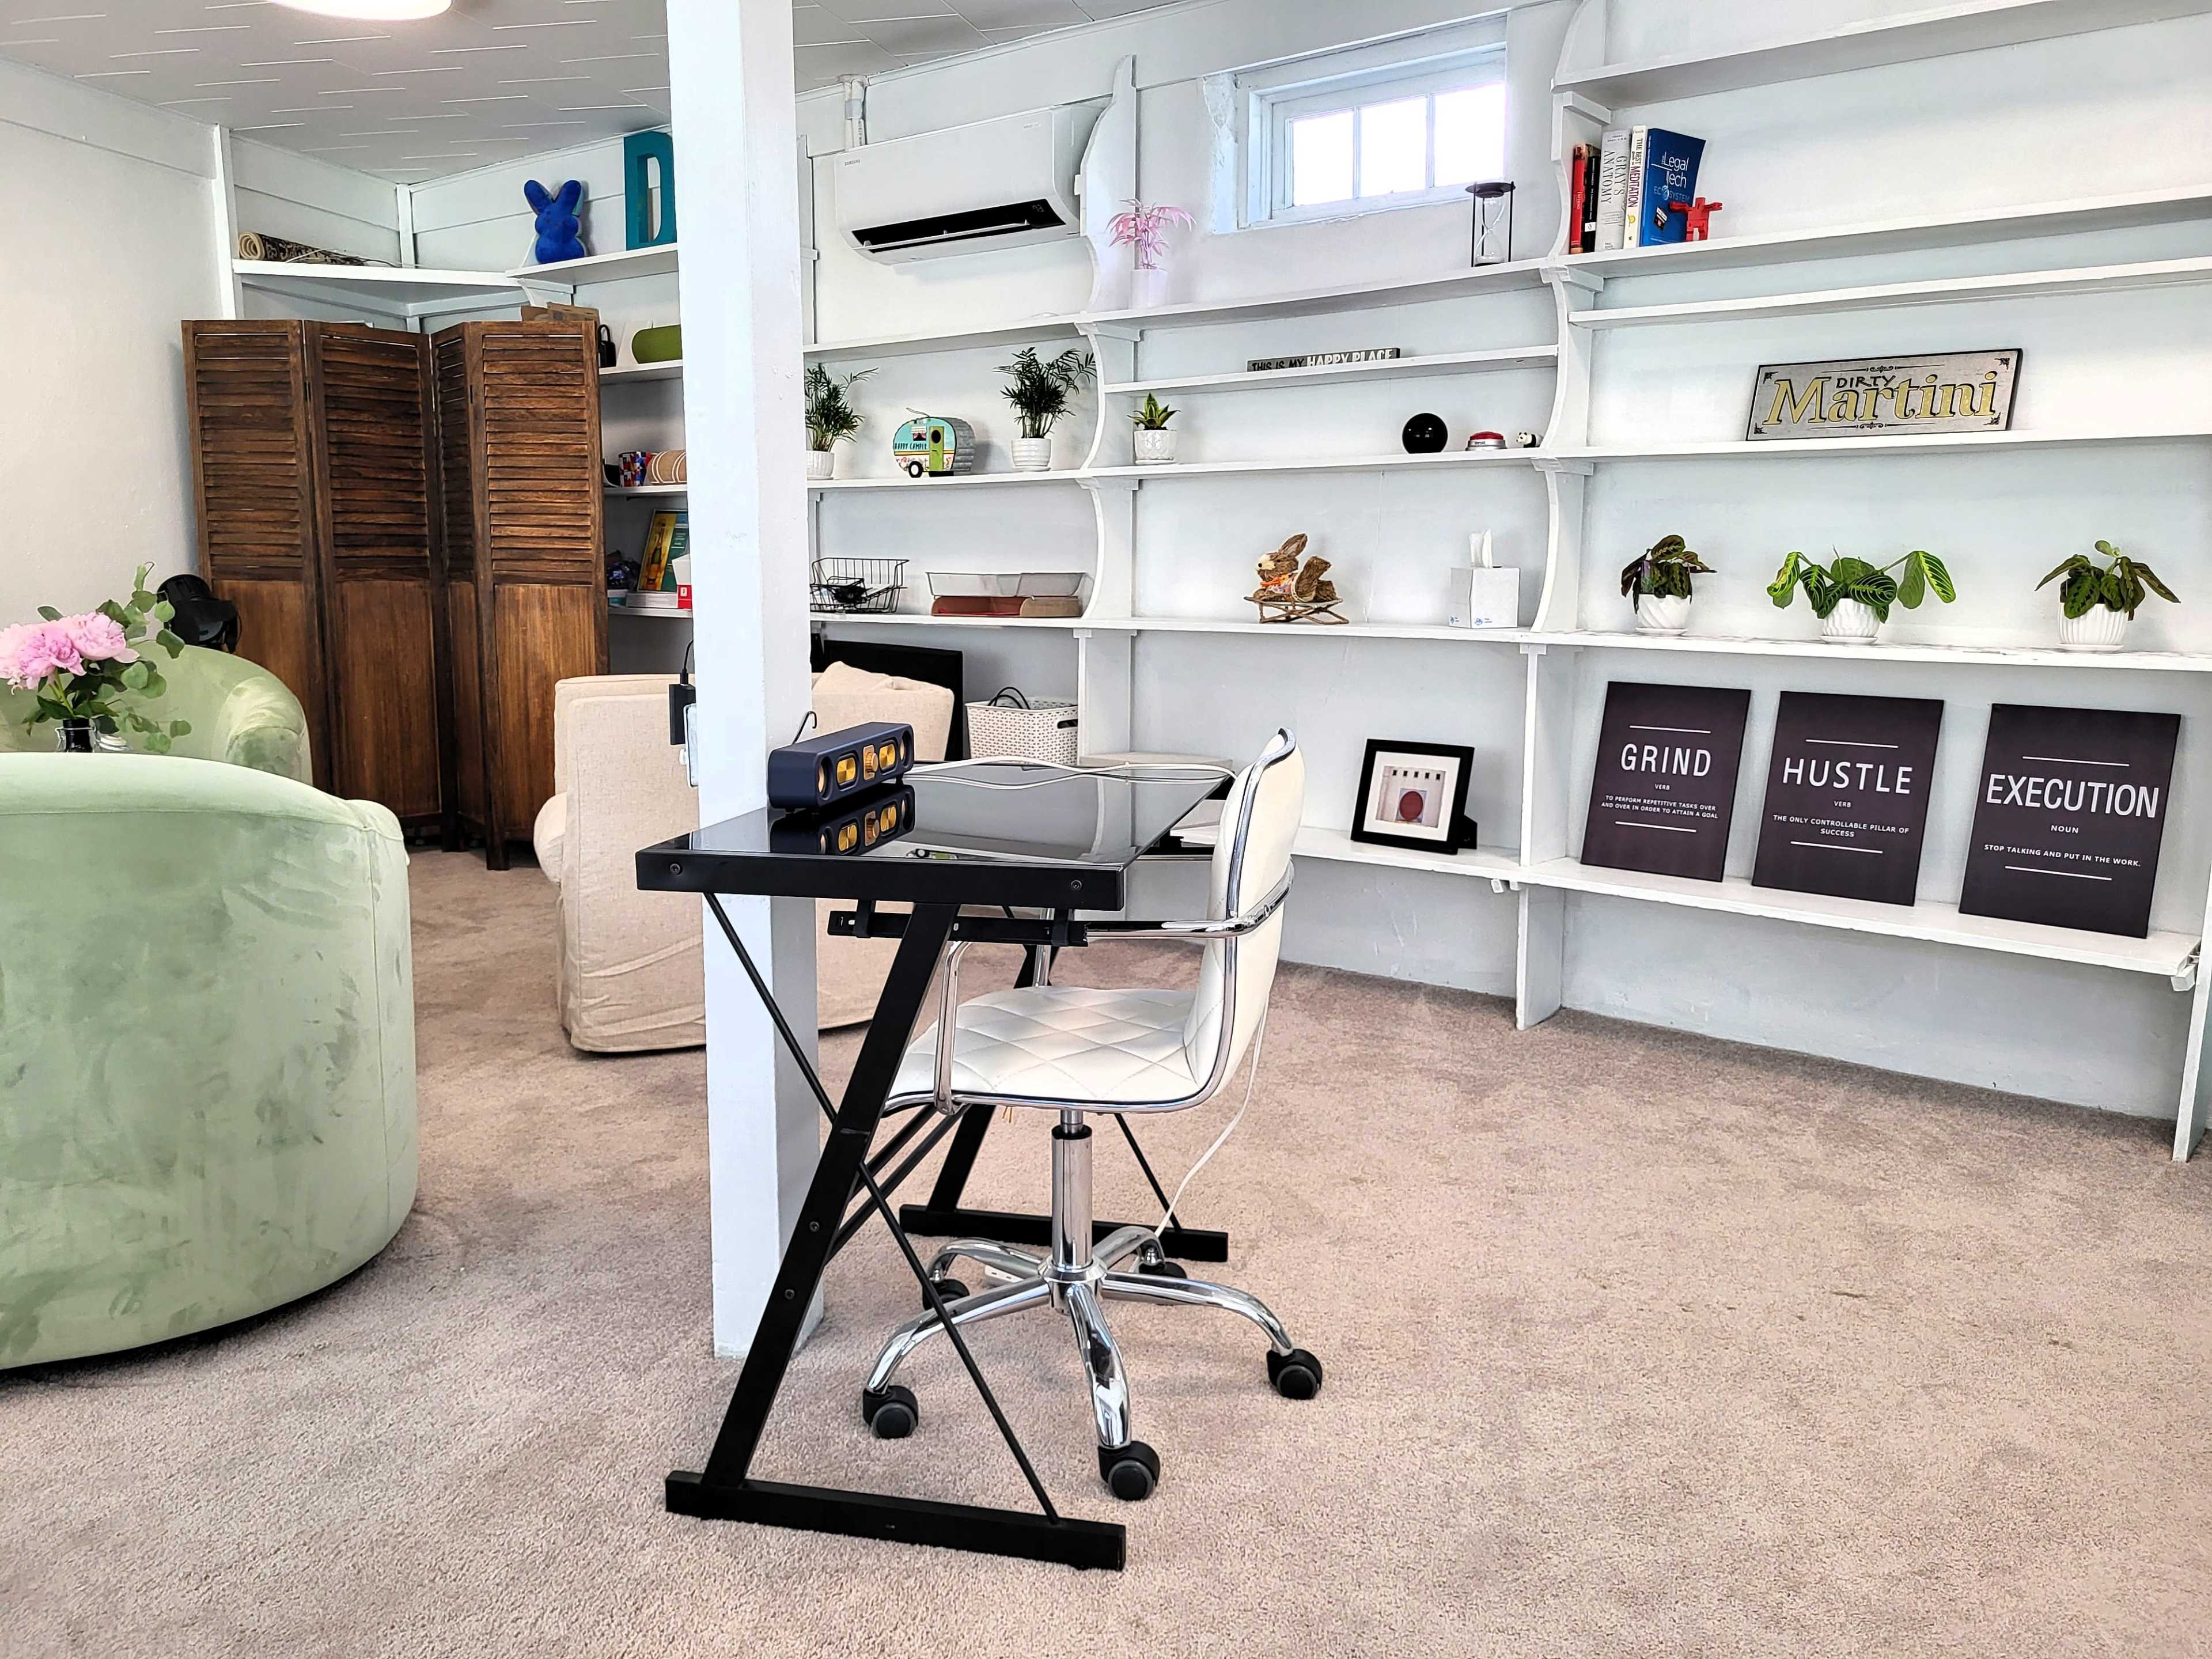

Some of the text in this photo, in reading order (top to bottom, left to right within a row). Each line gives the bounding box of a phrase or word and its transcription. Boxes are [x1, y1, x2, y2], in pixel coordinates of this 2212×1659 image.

[1664, 151, 1690, 172] Legal
[1601, 150, 1615, 203] ANATOMY
[1613, 156, 1627, 195] GRAY'S
[1627, 166, 1641, 207] MEDITATION
[1252, 362, 1272, 372] THIS
[1275, 361, 1285, 369] IS
[1288, 358, 1305, 369] MY
[1306, 353, 1350, 366] HAPPY
[1835, 374, 1896, 389] DIRTY
[1762, 370, 1999, 425] Martini
[1620, 743, 1711, 777] GRIND
[1782, 757, 1912, 794] HUSTLE
[1986, 773, 2159, 819] EXECUTION
[1789, 816, 1808, 824] ONLY
[1810, 819, 1867, 830] CONTROLLABLE
[1870, 824, 1896, 832] PILLAR
[1820, 828, 1855, 837] SUCCESS
[2051, 824, 2079, 834] NOUN
[2007, 846, 2041, 855] TALKING
[2043, 850, 2062, 858] AND
[2064, 852, 2080, 860] PUT
[2094, 855, 2111, 863] THE
[2113, 857, 2141, 867] WORK.
